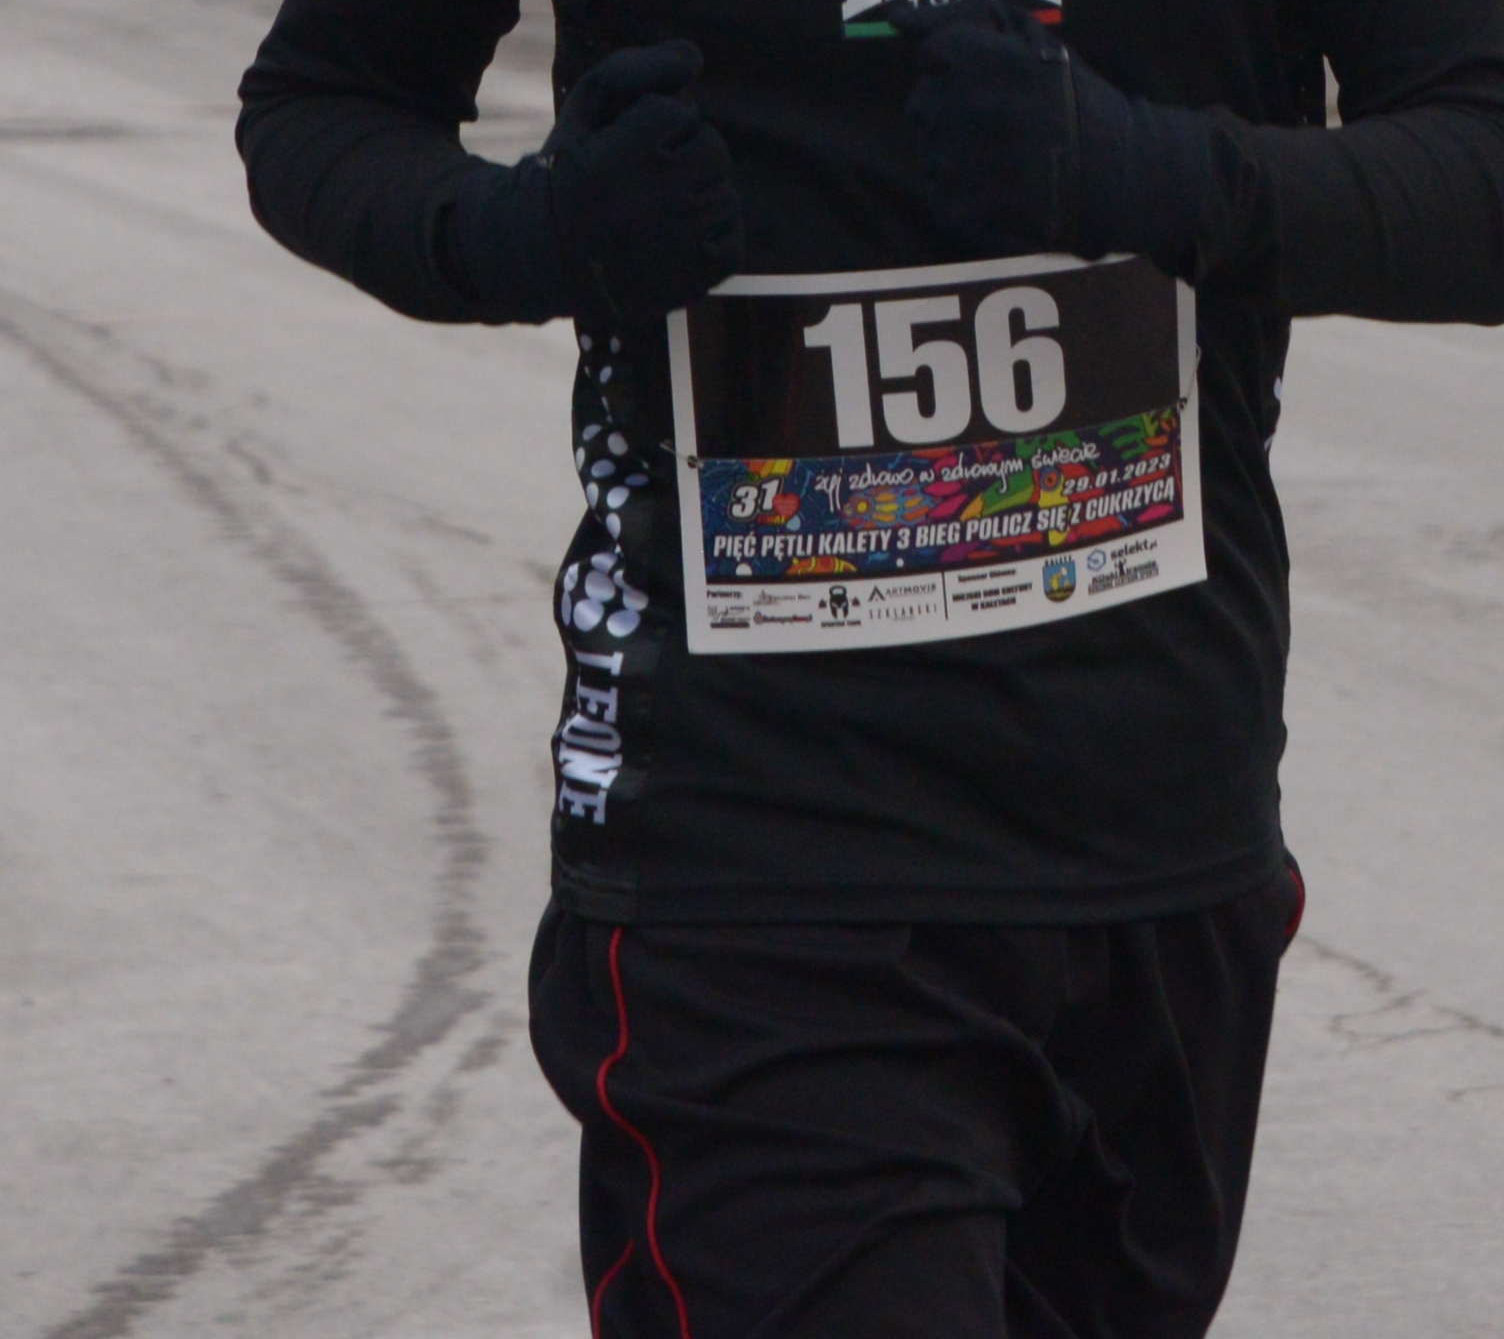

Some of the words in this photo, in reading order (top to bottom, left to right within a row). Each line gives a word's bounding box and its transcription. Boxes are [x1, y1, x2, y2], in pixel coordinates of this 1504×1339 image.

[803, 286, 1067, 448] 156
[729, 476, 782, 521] 31
[849, 462, 914, 490] zdrowo
[919, 469, 935, 483] w
[942, 452, 1024, 494] zdrowym
[1062, 453, 1172, 496] 29.01.2023
[713, 531, 756, 563] PIĘĆ
[761, 533, 813, 563] PĘTLI
[818, 528, 892, 557] KALETY
[896, 527, 911, 551] 3
[915, 520, 961, 548] BIEG
[965, 510, 1033, 542] POLICZ
[1036, 506, 1067, 533] SIĘ
[1070, 502, 1083, 525] Z
[1085, 475, 1176, 521] CUKRZYCĄ
[558, 650, 624, 825] LEONE
